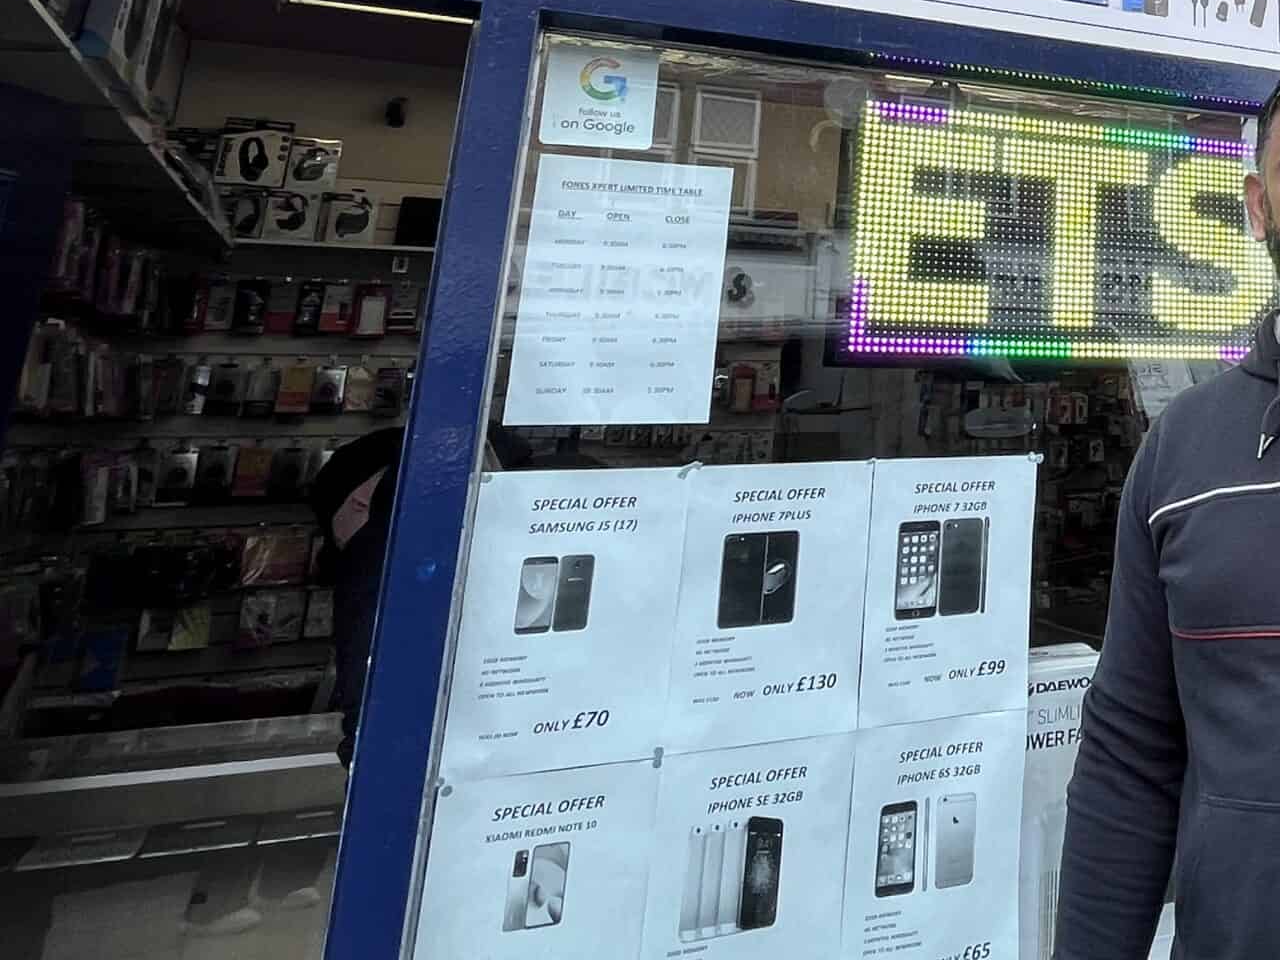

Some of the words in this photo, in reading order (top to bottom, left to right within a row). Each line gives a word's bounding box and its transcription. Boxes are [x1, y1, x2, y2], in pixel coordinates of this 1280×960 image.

[560, 120, 579, 129] on
[583, 118, 635, 135] Google
[733, 490, 783, 503] SPECIAL
[787, 487, 826, 501] OFFER
[914, 482, 958, 495] SPECIAL
[961, 480, 996, 492] OFFER
[531, 497, 588, 512] SPECIAL
[592, 496, 638, 510] OFFER
[913, 502, 951, 514] IPHONE
[961, 501, 988, 512] 32GB
[528, 520, 595, 534] SAMSUNG
[597, 519, 610, 532] J5
[612, 518, 638, 533] (17)
[732, 511, 776, 524] IPHONE
[778, 509, 812, 521] 7PLUS
[949, 667, 976, 680] ONLY
[976, 659, 1006, 677] £99
[733, 690, 756, 700] NOW
[762, 682, 794, 696] ONLY
[796, 672, 837, 692] £130
[1036, 676, 1091, 694] DAEWO
[533, 719, 570, 735] ONLY
[571, 709, 611, 730] £70
[1038, 703, 1080, 725] SLIMLI
[1026, 730, 1065, 751] WER
[1068, 727, 1082, 745] FA
[899, 746, 943, 764] SPECIAL
[946, 741, 984, 756] OFFER
[709, 772, 762, 790] SPECIAL
[766, 766, 808, 782] OFFER
[897, 769, 937, 785] IPHONE
[938, 767, 951, 779] 6S
[953, 764, 981, 777] 32GB
[491, 802, 553, 822] SPECIAL
[558, 795, 605, 813] OFFER
[707, 797, 754, 815] IPHONE
[756, 794, 770, 807] SE
[772, 790, 804, 805] 32GB
[485, 830, 522, 843] XIAOMI
[524, 825, 556, 838] REDMI
[557, 821, 583, 833] NOTE
[585, 819, 598, 830] 10
[963, 941, 991, 960] £65
